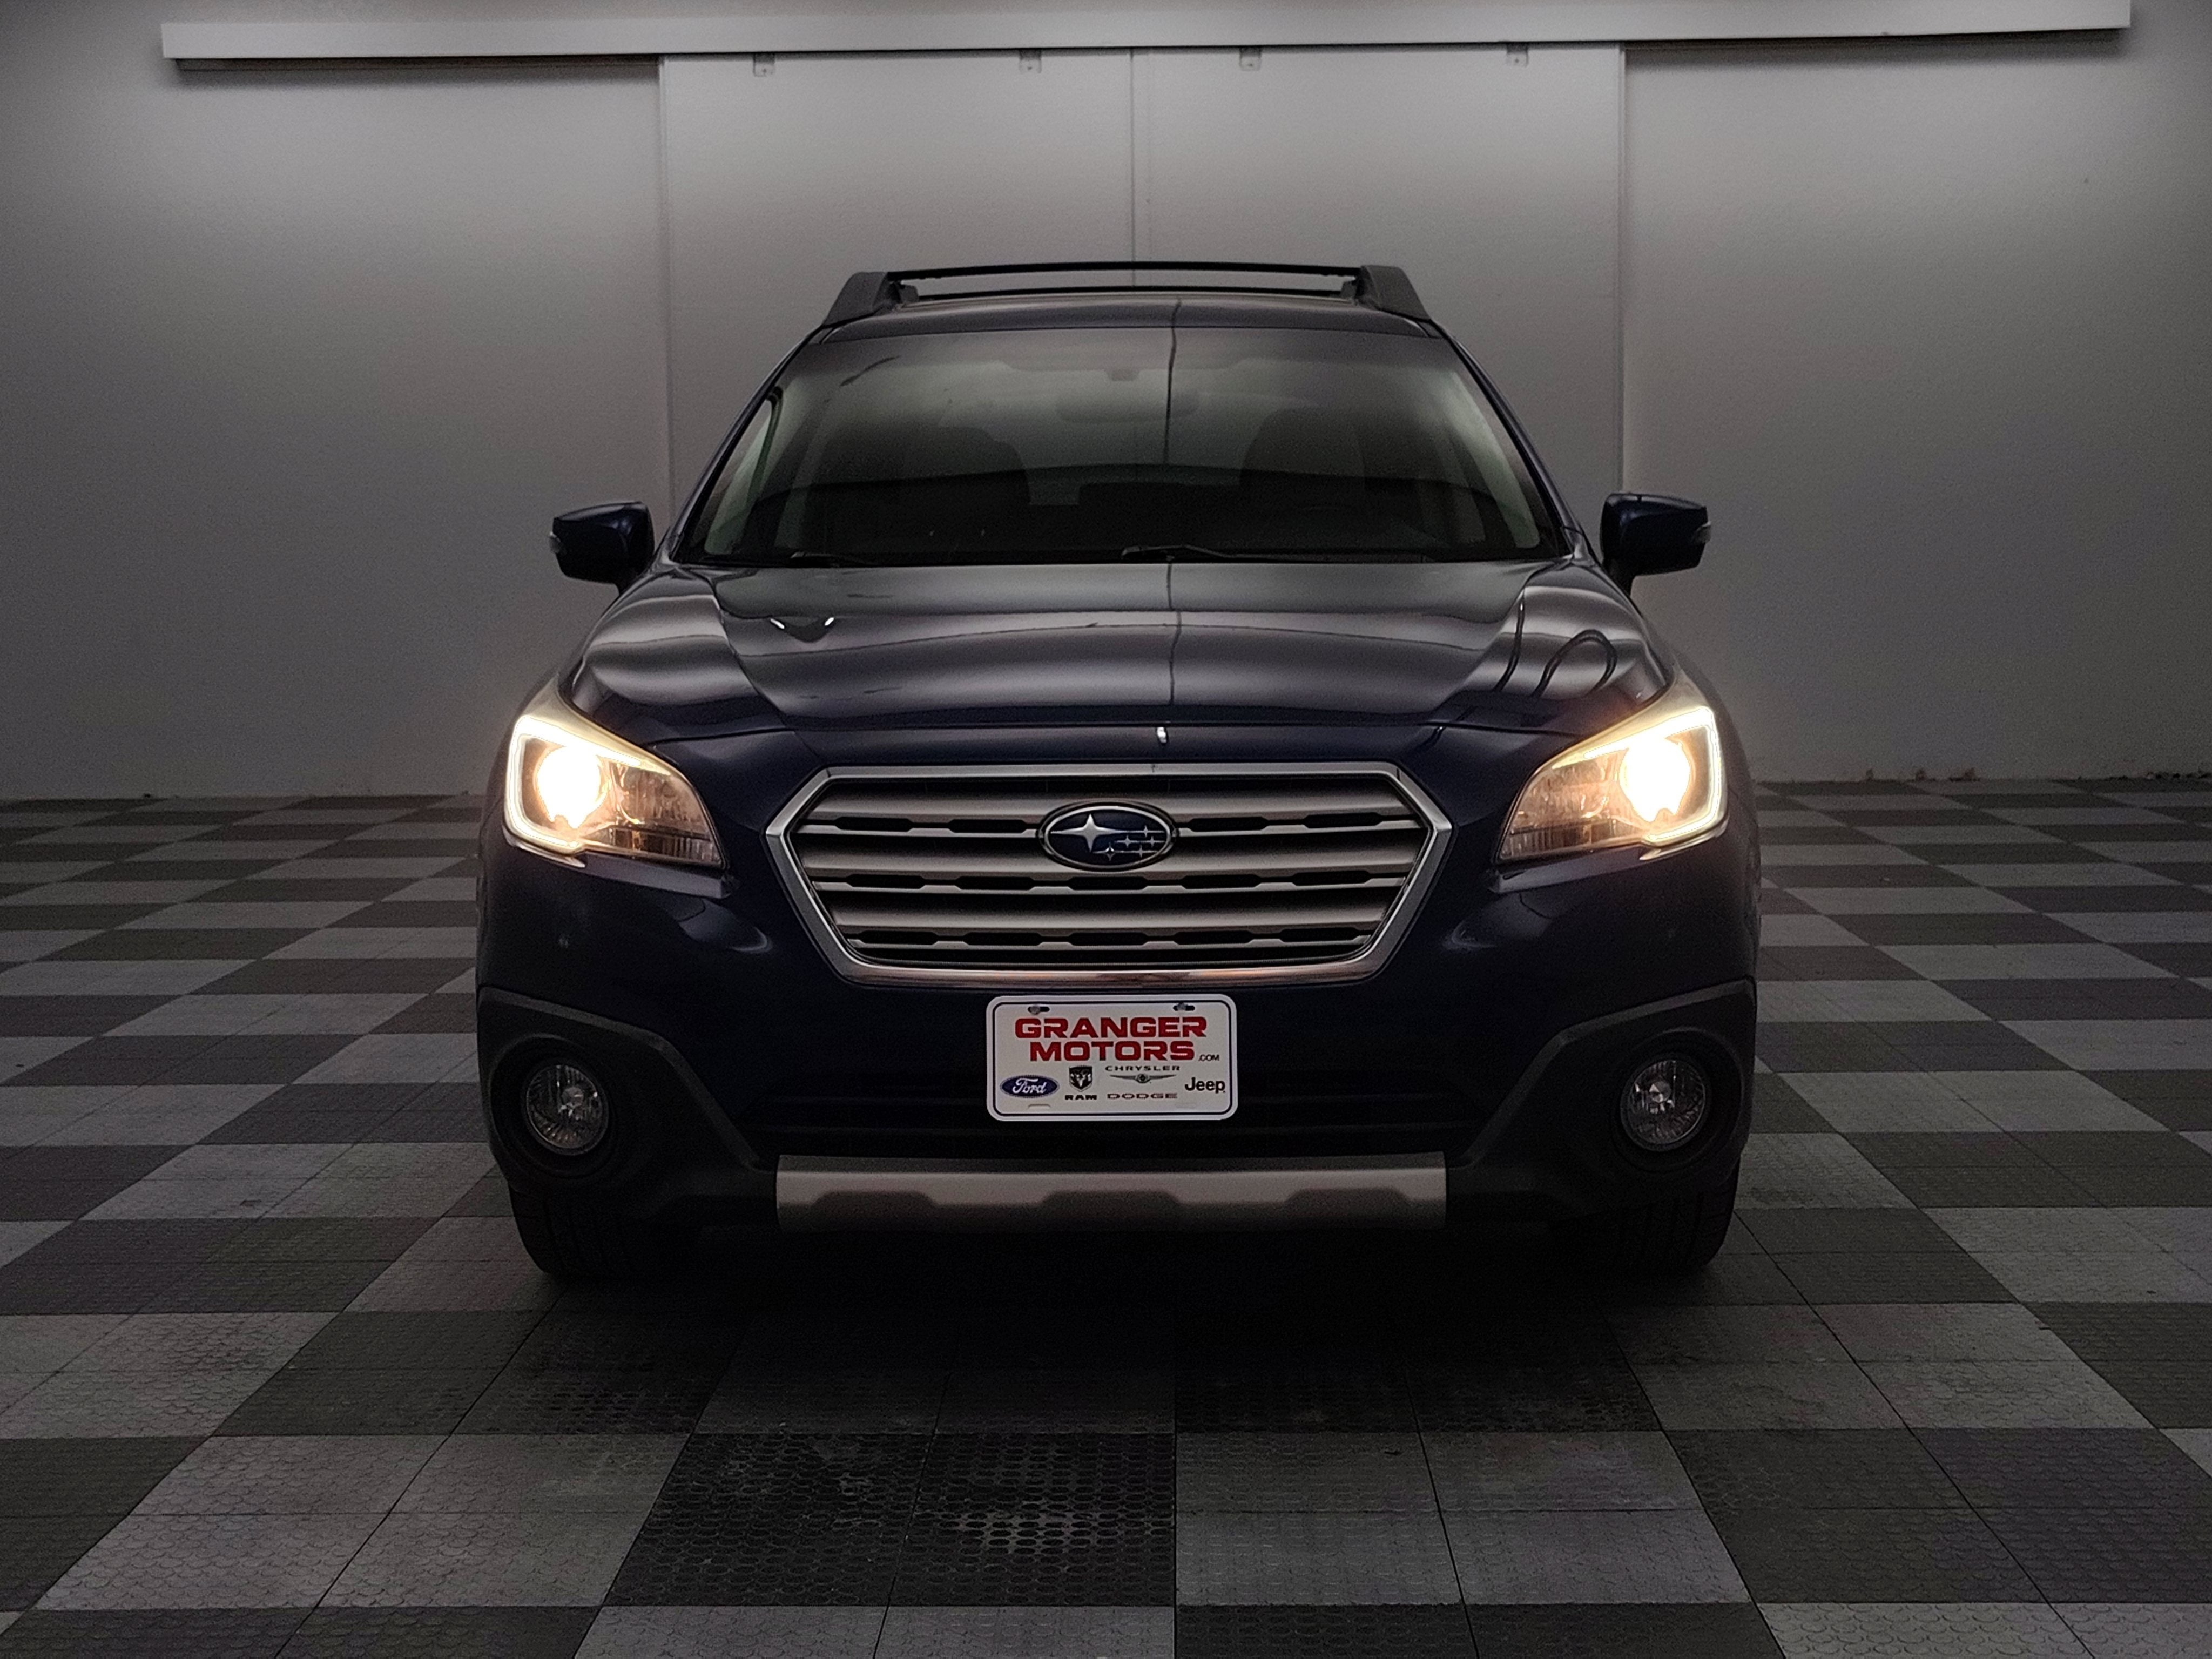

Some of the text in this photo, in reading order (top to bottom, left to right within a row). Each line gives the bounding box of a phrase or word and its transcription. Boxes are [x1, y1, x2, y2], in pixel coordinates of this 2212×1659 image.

[1015, 1016, 1208, 1038] GRANGER
[1029, 1041, 1195, 1062] MOTORS
[1013, 1077, 1047, 1094] Ford
[1185, 1077, 1225, 1094] Jeep
